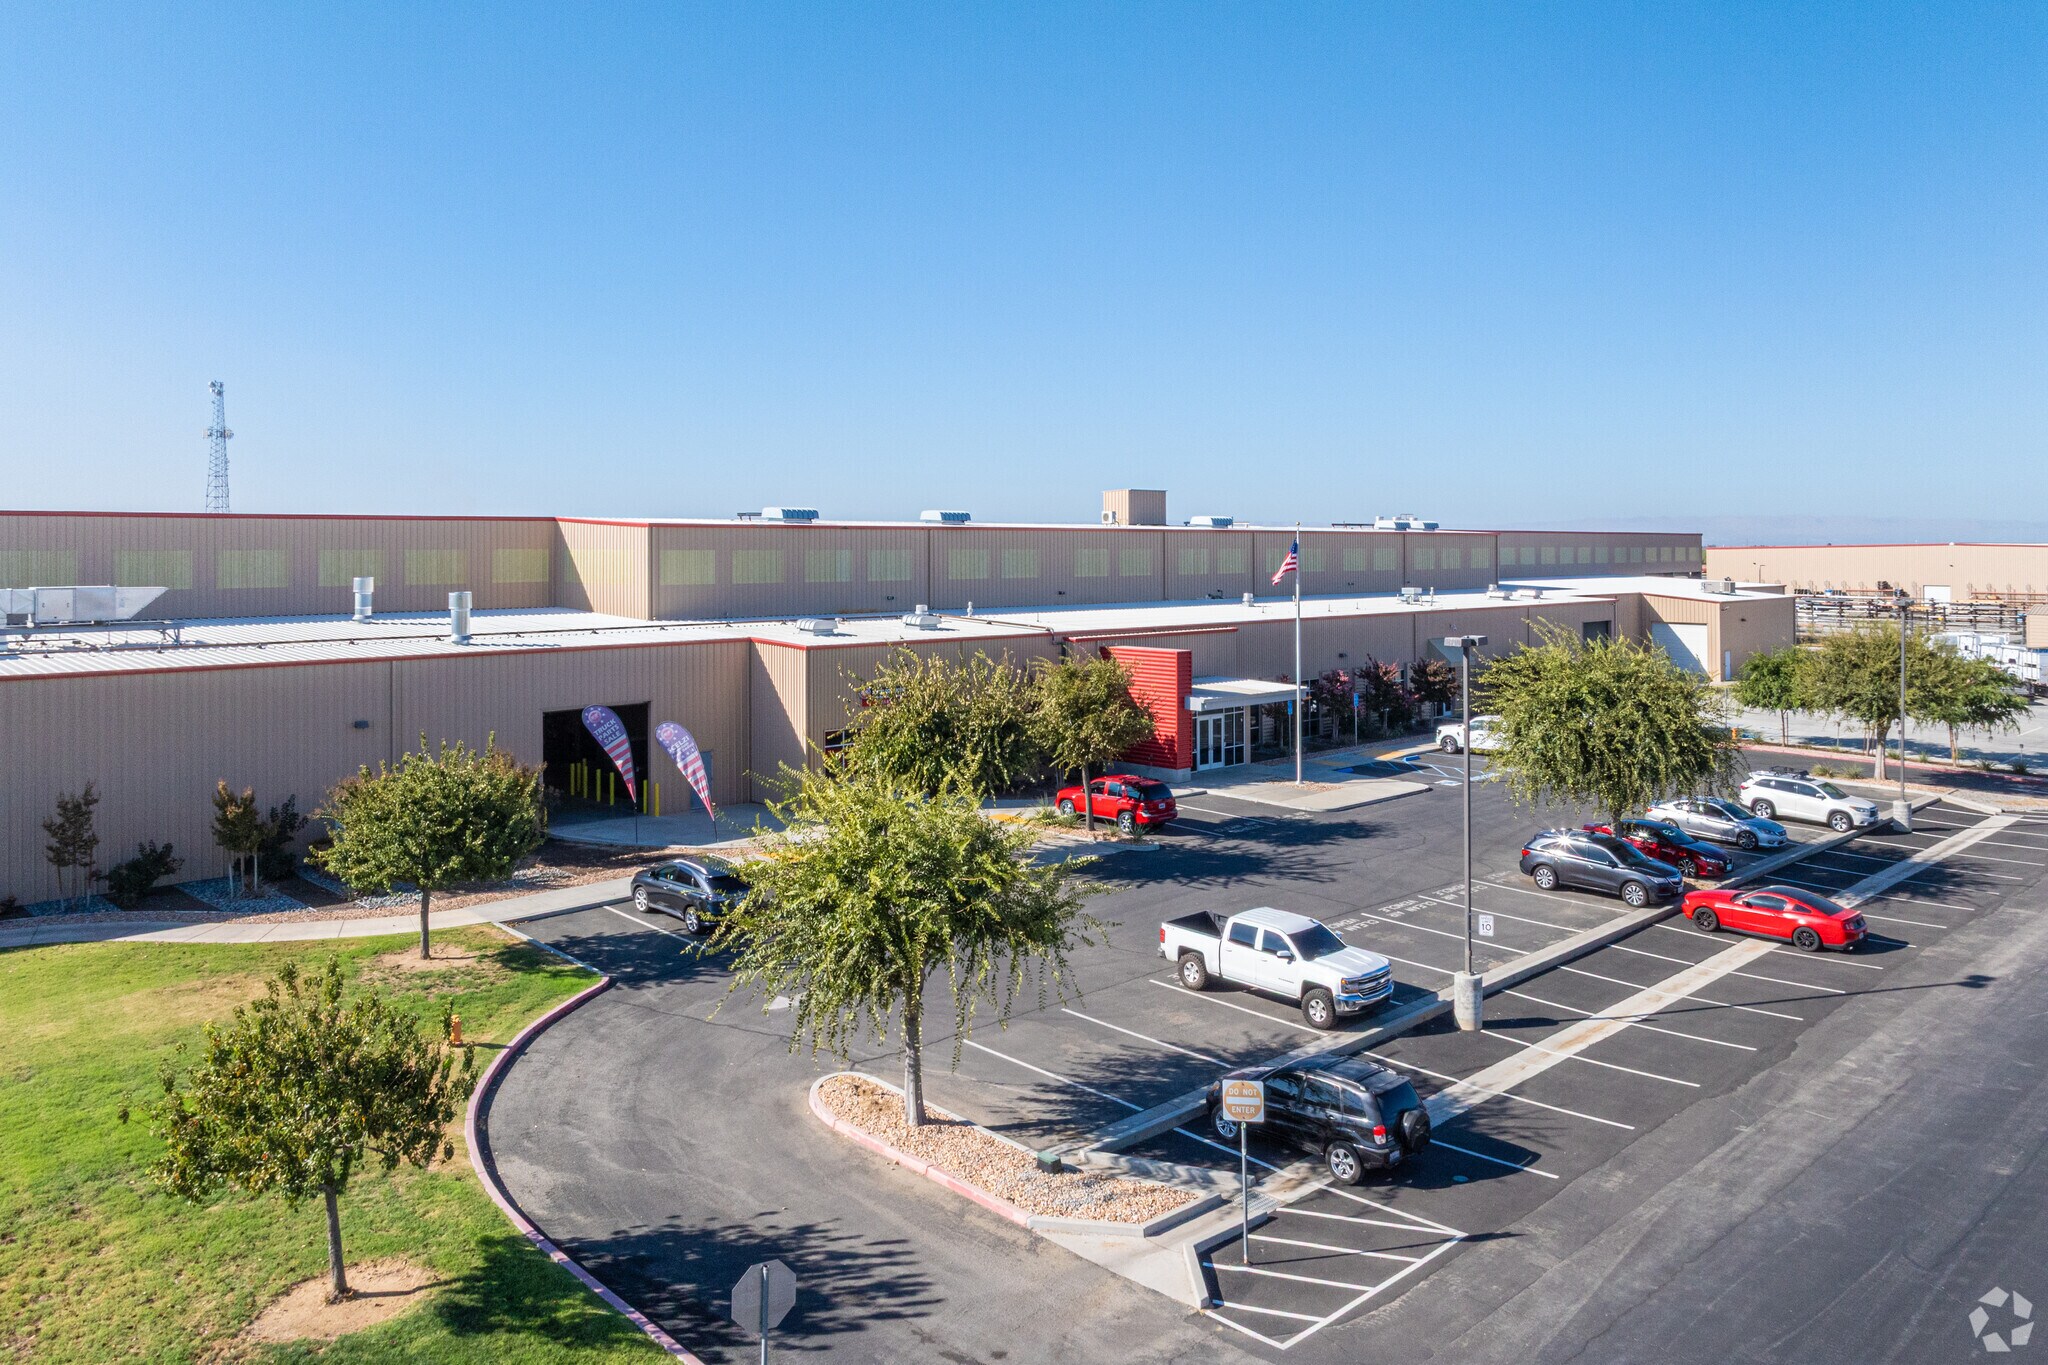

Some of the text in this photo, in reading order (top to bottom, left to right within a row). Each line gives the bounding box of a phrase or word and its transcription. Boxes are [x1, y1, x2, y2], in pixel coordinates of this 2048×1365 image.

[593, 718, 617, 736] TRUCK
[598, 724, 620, 741] PARTS
[604, 731, 621, 745] SALE
[1481, 923, 1492, 931] 10
[1228, 1087, 1258, 1096] DO NOT
[1231, 1105, 1256, 1114] ENTER
